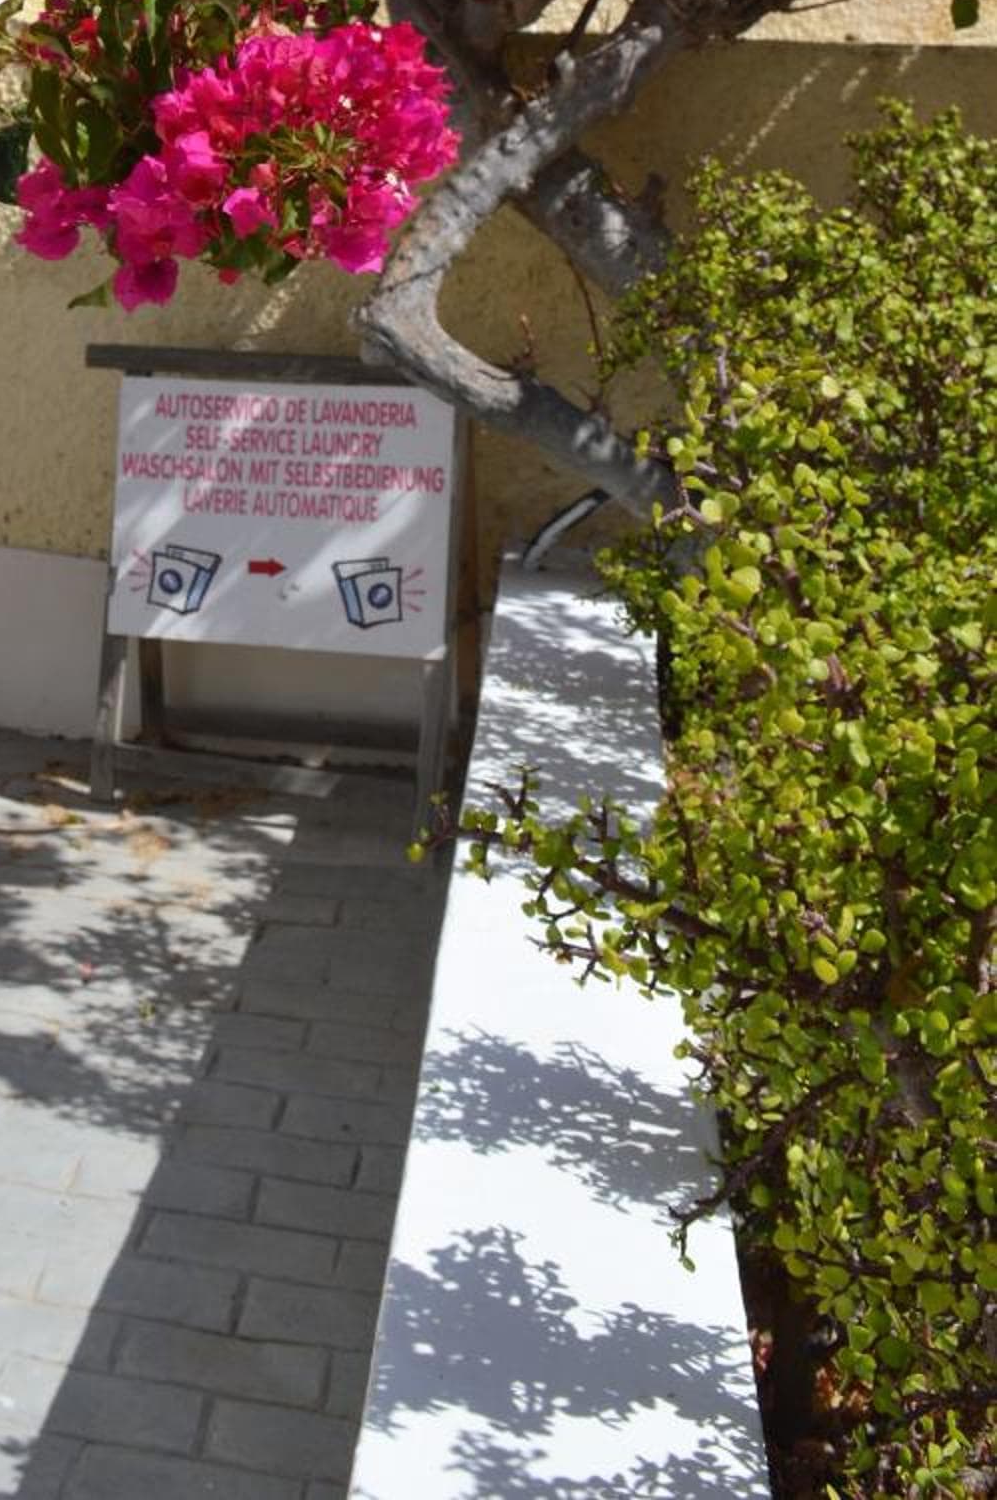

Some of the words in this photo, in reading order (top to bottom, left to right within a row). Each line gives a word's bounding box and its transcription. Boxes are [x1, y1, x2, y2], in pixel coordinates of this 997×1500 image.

[155, 393, 279, 422] AUTOSERVICIO
[285, 400, 308, 424] DE
[302, 431, 383, 457] LAUNDRY
[122, 452, 243, 483] WASCHSALON
[249, 459, 281, 485] MIT
[284, 460, 445, 493] SELBSTBEDIENUNG
[184, 487, 248, 515] LAVERIE
[252, 490, 379, 522] AUTOMATIQUE
